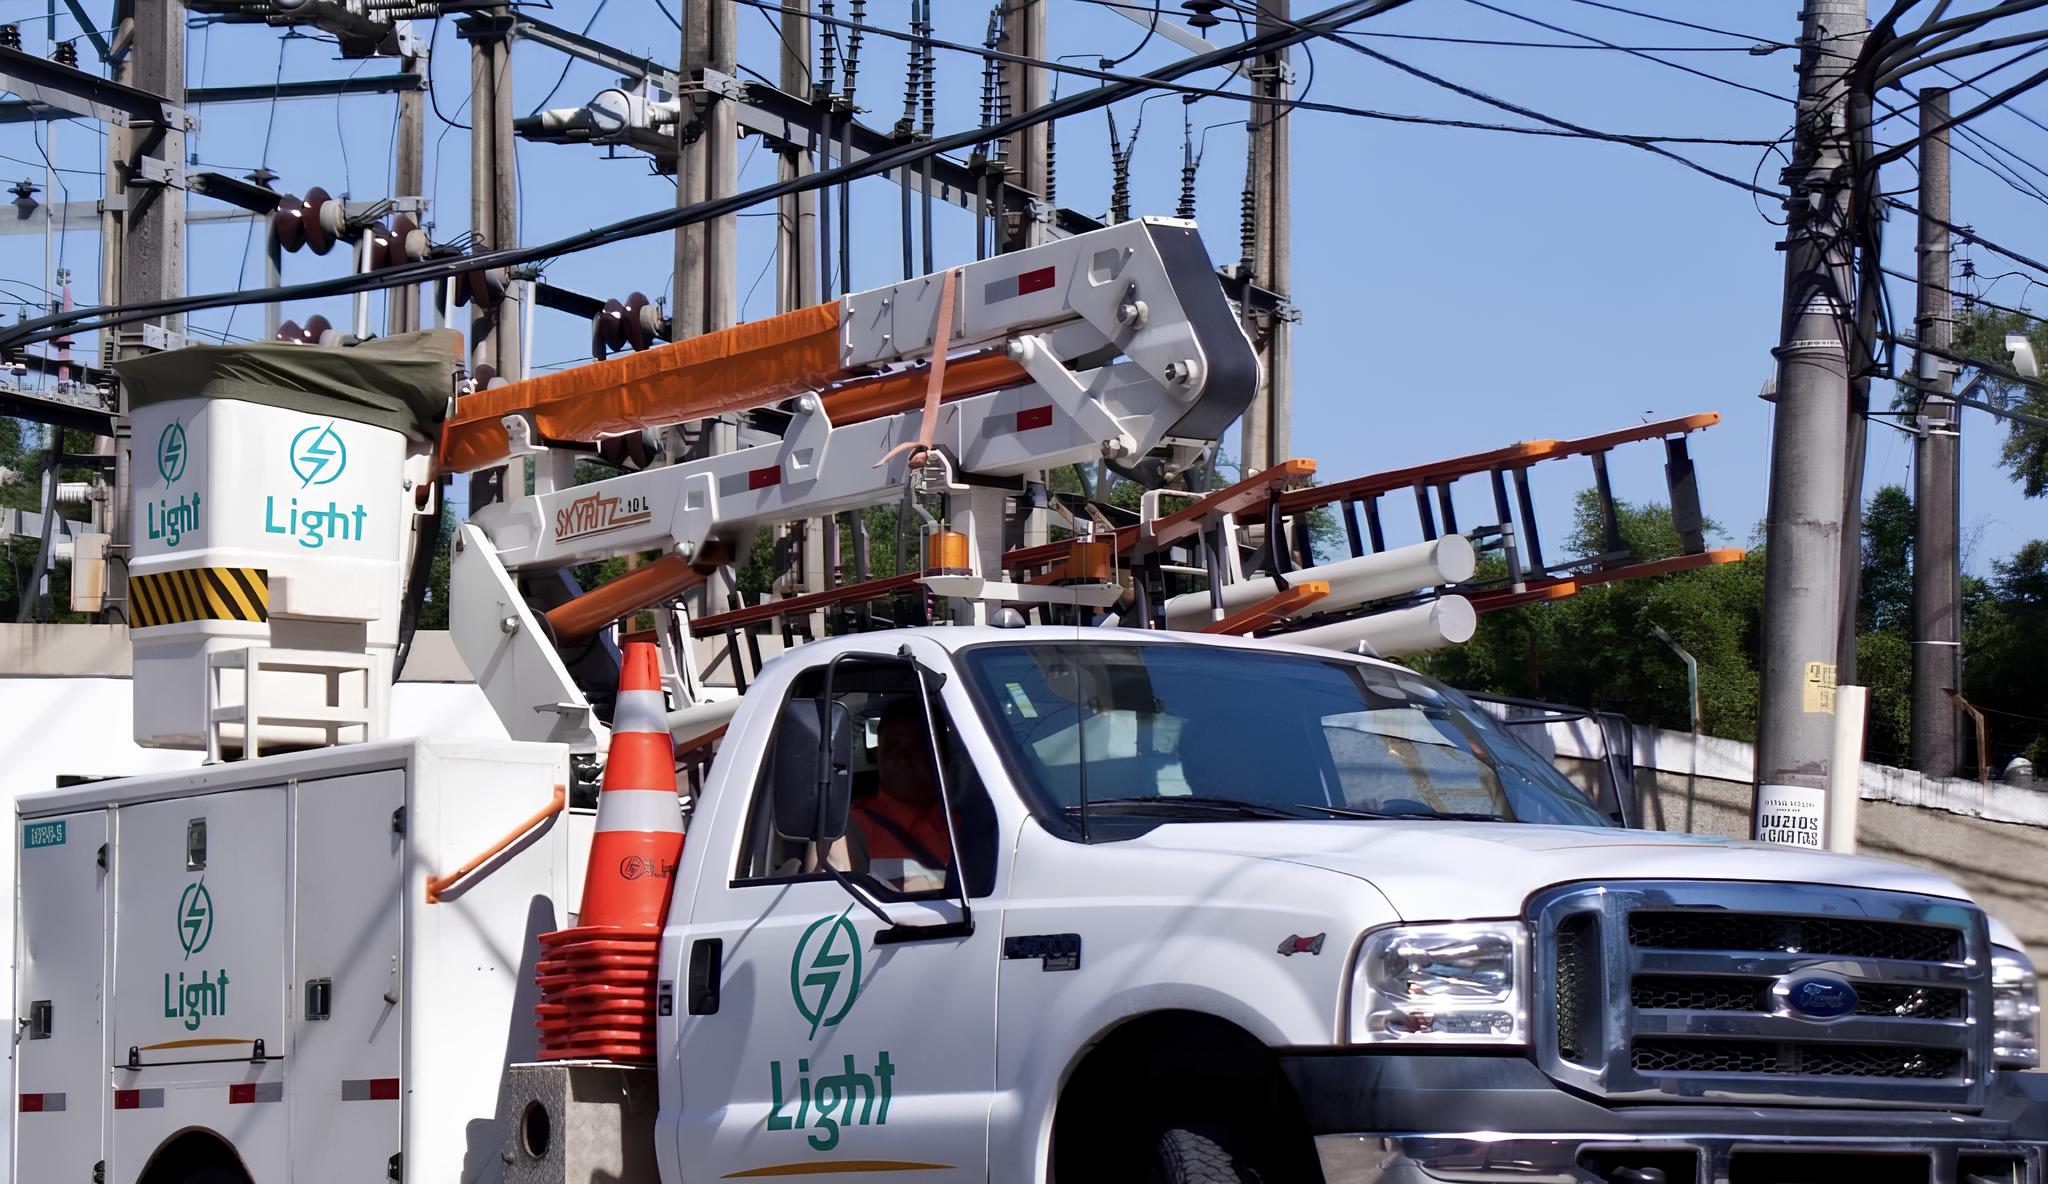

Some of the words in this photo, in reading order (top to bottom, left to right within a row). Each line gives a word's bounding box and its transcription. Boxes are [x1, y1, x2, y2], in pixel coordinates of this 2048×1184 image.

[148, 491, 201, 547] Light
[265, 496, 367, 549] Light
[166, 969, 229, 1030] Light
[767, 1052, 895, 1151] Light
